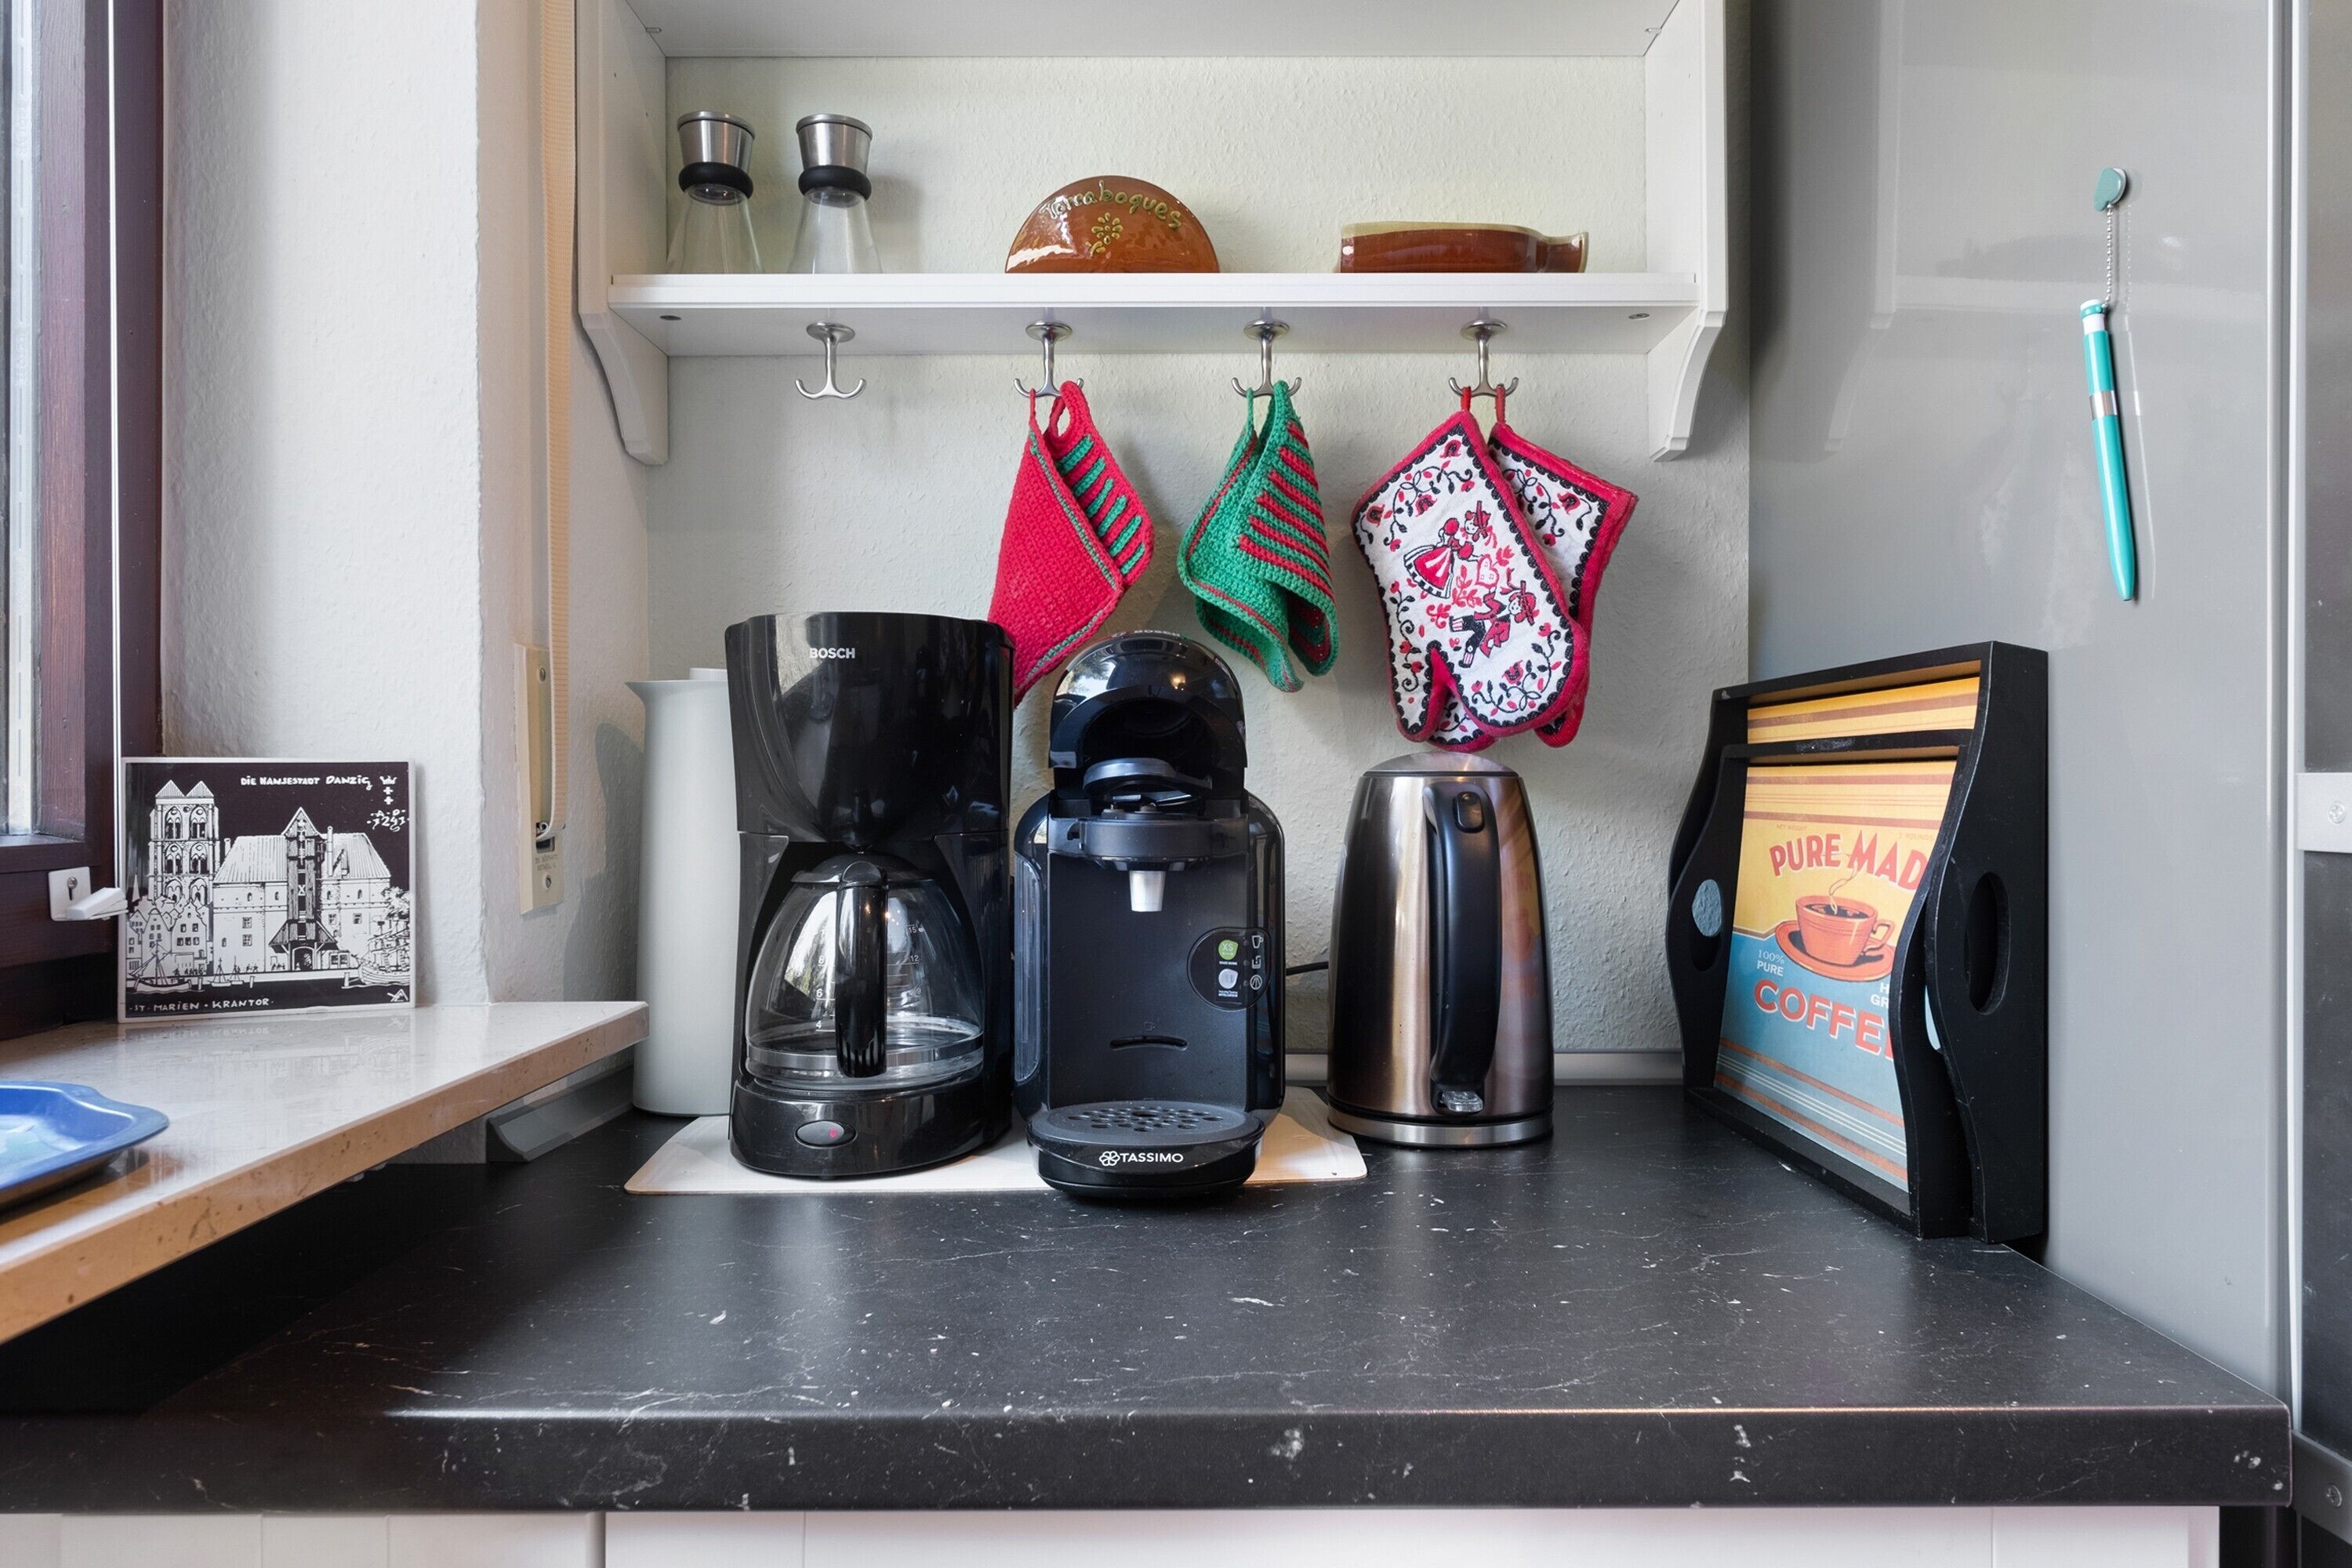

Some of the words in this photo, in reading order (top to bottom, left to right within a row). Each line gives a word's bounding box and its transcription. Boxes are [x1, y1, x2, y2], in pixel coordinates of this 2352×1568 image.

[809, 648, 855, 659] BOSCH
[1769, 833, 1842, 877] PURE
[818, 955, 824, 964] 8
[1758, 949, 1785, 964] 100%
[1756, 960, 1784, 977] PURE
[816, 989, 823, 997] 6
[154, 1000, 200, 1012] MARIEN
[212, 997, 269, 1009] KRANTOR
[815, 1020, 822, 1029] 4
[1754, 978, 1894, 1062] COFFE
[1120, 1152, 1184, 1163] TASSIMO
